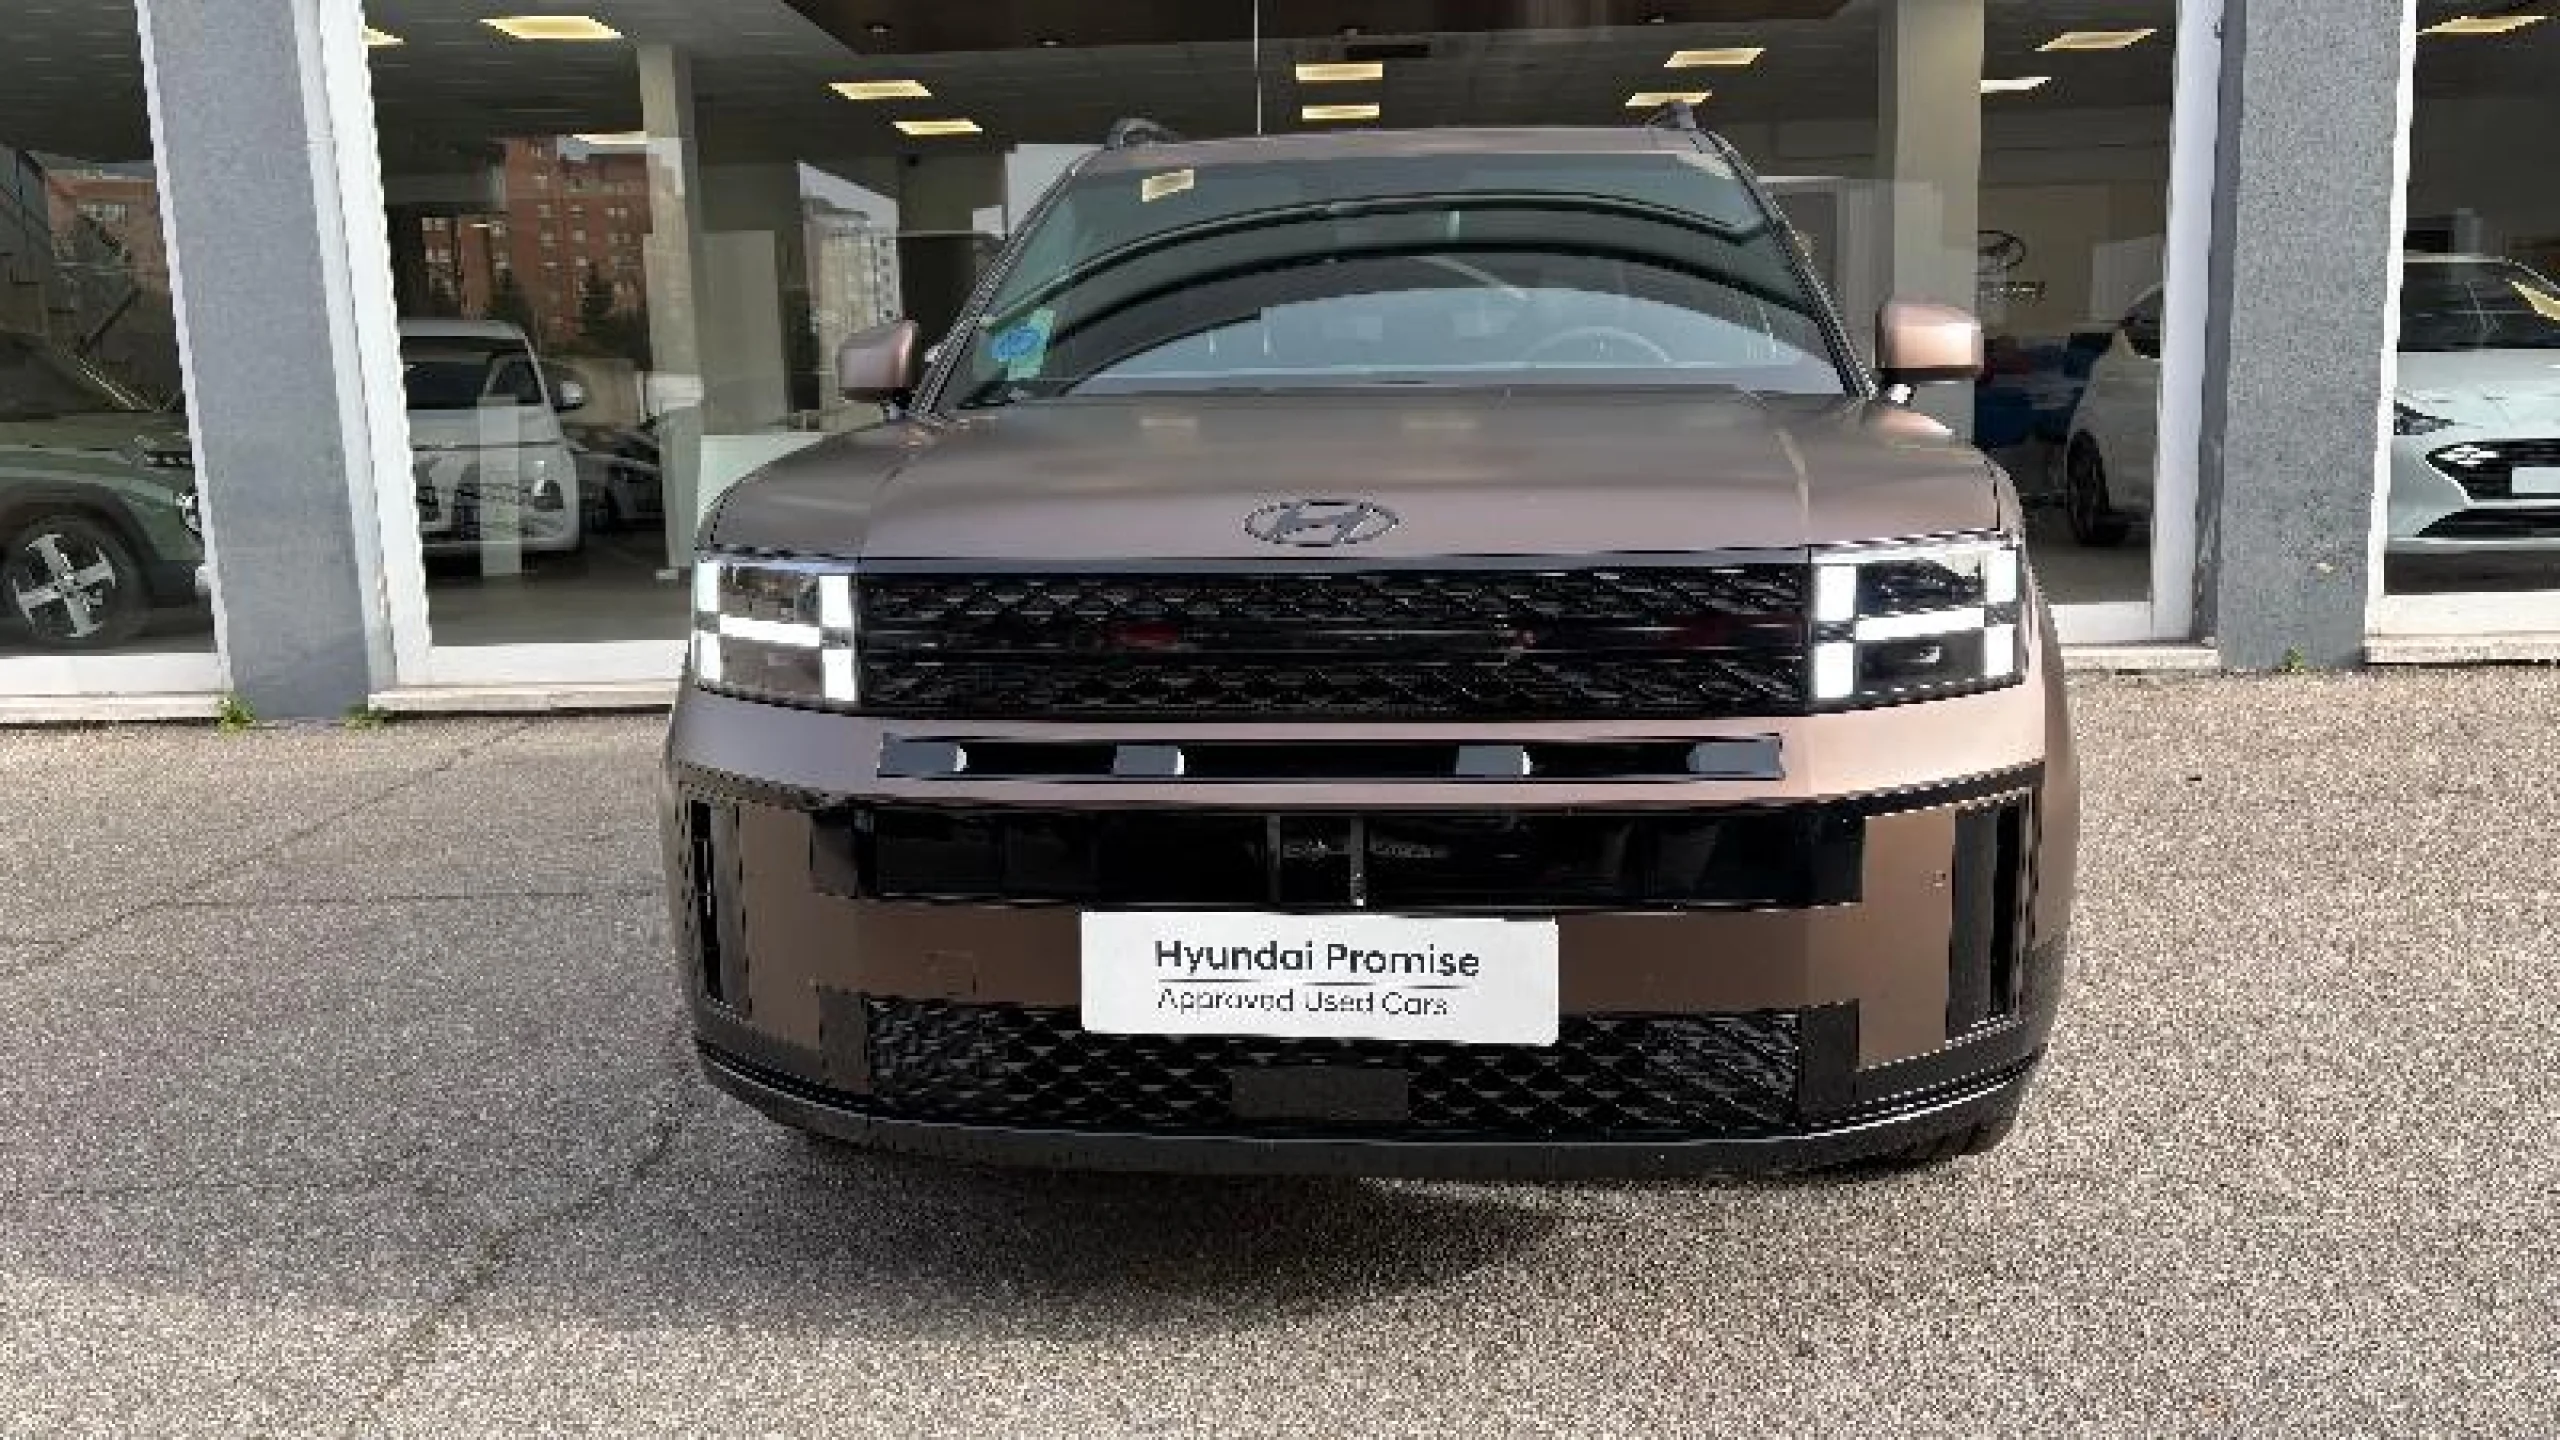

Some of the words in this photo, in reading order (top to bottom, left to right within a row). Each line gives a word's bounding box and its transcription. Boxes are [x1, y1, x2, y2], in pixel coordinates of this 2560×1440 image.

[1153, 938, 1315, 976] Hyundai
[1326, 942, 1480, 978] Promise
[1157, 987, 1295, 1015] Approved
[1304, 989, 1375, 1014] Used
[1382, 990, 1449, 1016] Cars
